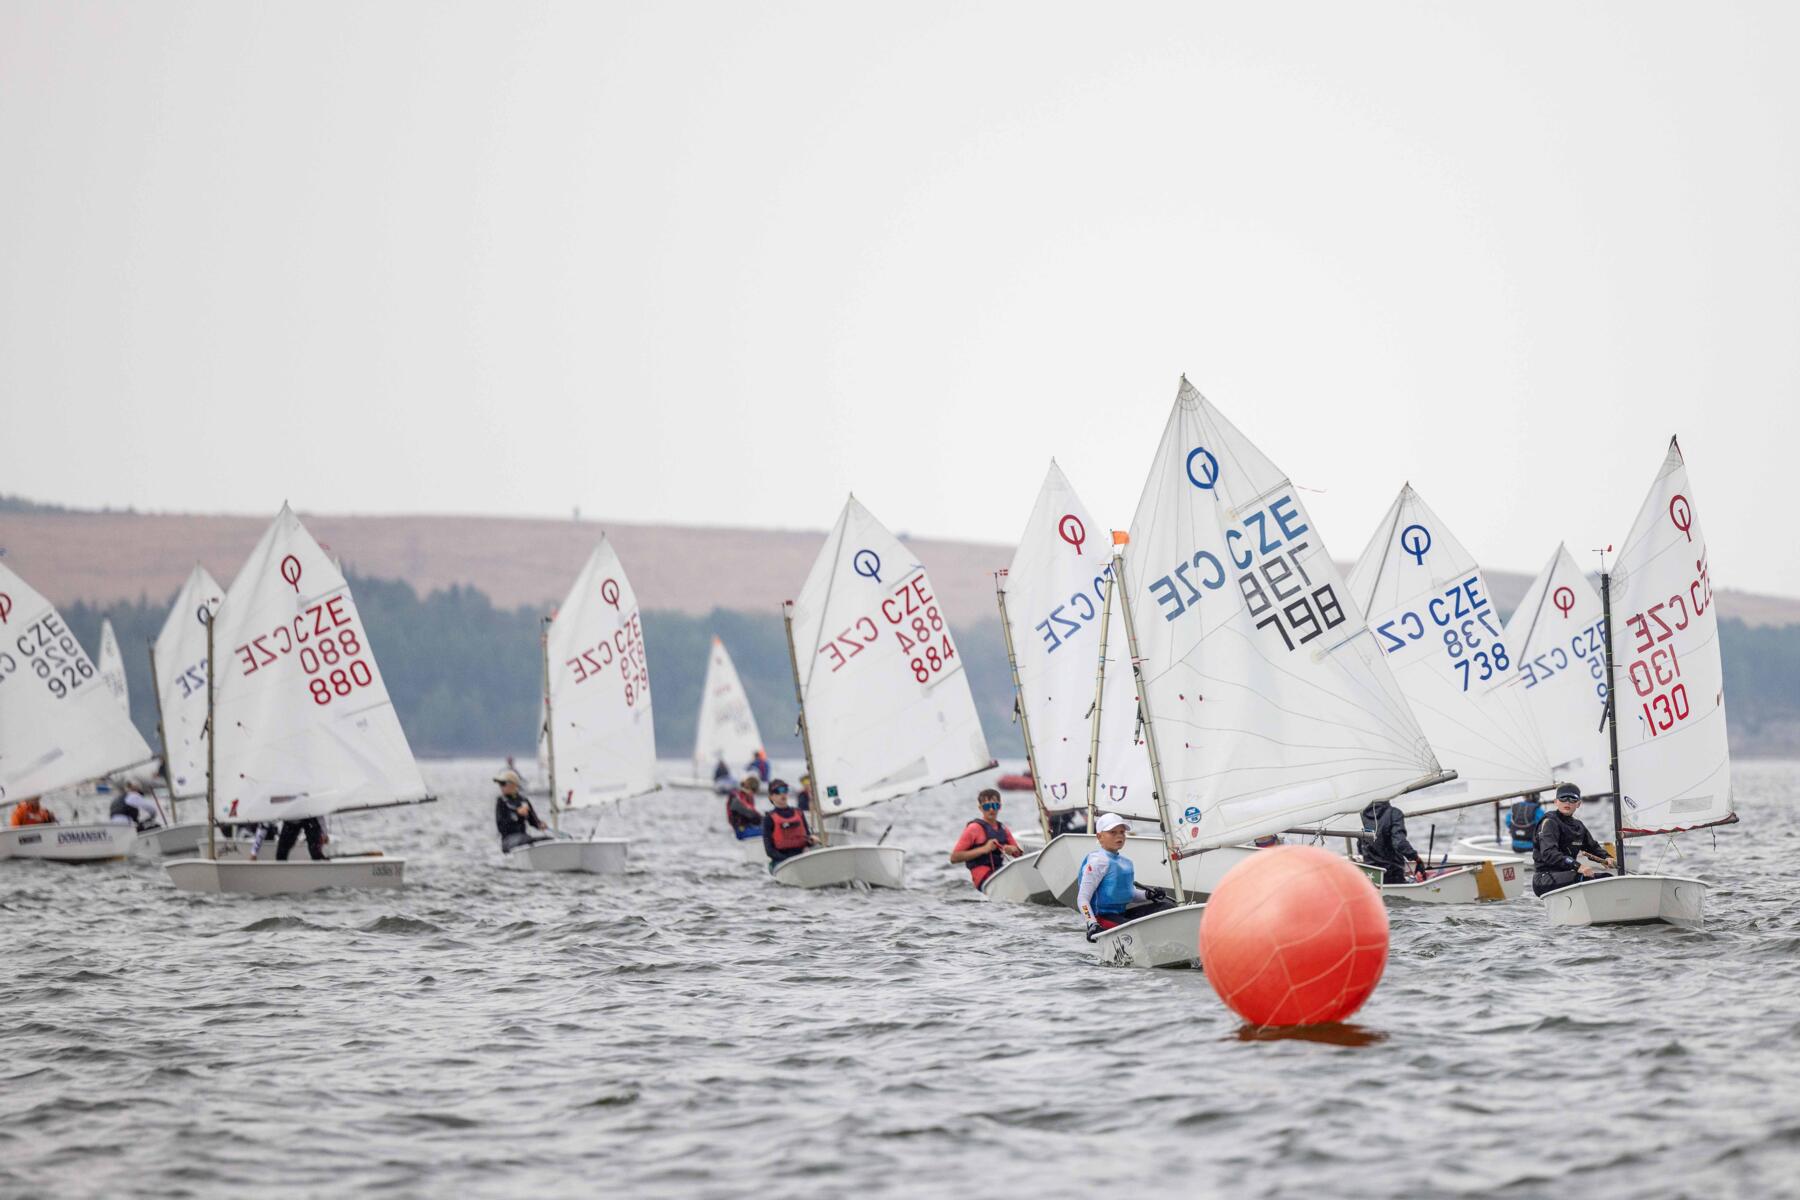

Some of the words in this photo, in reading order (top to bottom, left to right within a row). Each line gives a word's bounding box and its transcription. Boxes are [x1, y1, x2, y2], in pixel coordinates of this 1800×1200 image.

[1226, 495, 1309, 570] CZE
[294, 596, 351, 643] CZE
[882, 574, 933, 624] CZE
[1256, 583, 1346, 651] 798
[1429, 576, 1487, 626] CZE
[17, 613, 65, 657] CZE
[615, 613, 641, 653] CZE
[48, 657, 93, 699] 926
[309, 660, 372, 705] 880
[911, 634, 954, 683] 884
[1454, 643, 1510, 692] 738
[1643, 684, 1690, 737] 130
